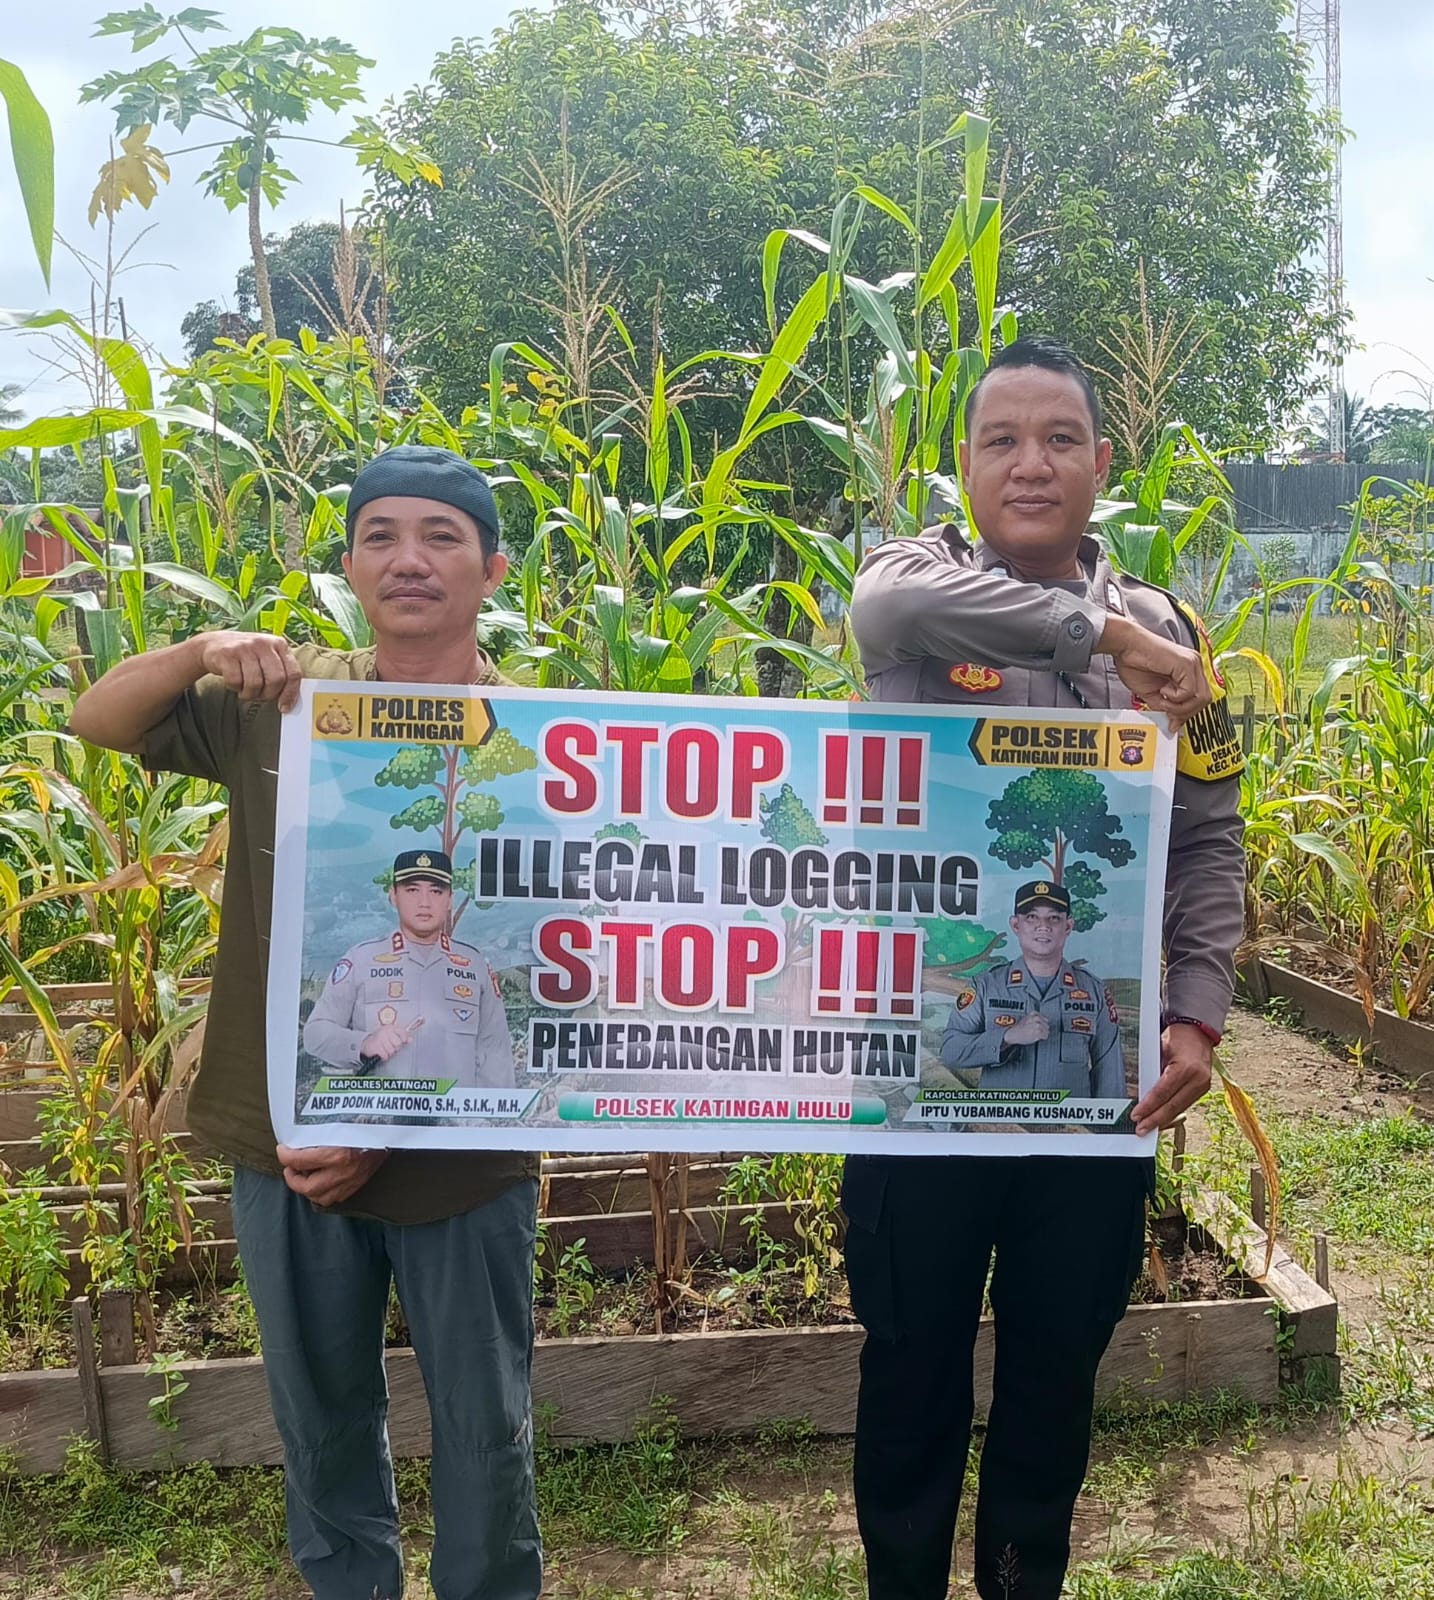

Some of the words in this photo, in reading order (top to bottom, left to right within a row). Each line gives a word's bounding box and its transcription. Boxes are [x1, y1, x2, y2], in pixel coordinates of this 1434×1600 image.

[371, 697, 464, 722] POLRES
[370, 722, 464, 741] KATINGAN
[990, 724, 1098, 750] POLSEK
[990, 749, 1060, 766] KATINGAN
[1061, 751, 1099, 768] HULU
[542, 721, 786, 820] STOP
[823, 734, 923, 826] !!!
[479, 837, 705, 904] ILLEGAL
[720, 846, 979, 917] LOGGING
[370, 967, 404, 978] DODIK
[446, 967, 477, 981] POLRI
[537, 918, 779, 1009] STOP
[816, 928, 917, 1016] !!!
[1064, 1001, 1095, 1012] POLRI
[531, 1021, 782, 1074] PENEBANGAN
[791, 1029, 917, 1079] HUTAN
[330, 1079, 381, 1090] KAPOLRES
[383, 1080, 436, 1091] KATINGAN
[310, 1096, 340, 1110] AKBP
[341, 1096, 374, 1109] DODIK
[376, 1096, 433, 1114] HARTONO,
[497, 1099, 521, 1113] M.H.
[924, 1091, 977, 1100] KAPOLSEK
[979, 1091, 1030, 1101] KATINGAN
[1032, 1092, 1060, 1101] HULU
[594, 1097, 676, 1116] POLSEK
[683, 1098, 790, 1118] KATINGAN
[796, 1100, 851, 1119] HULU
[920, 1105, 949, 1118] IPTU
[953, 1106, 1031, 1119] YUBAMBANG
[1033, 1106, 1094, 1121] KUSNADY,
[1097, 1108, 1115, 1120] SH
